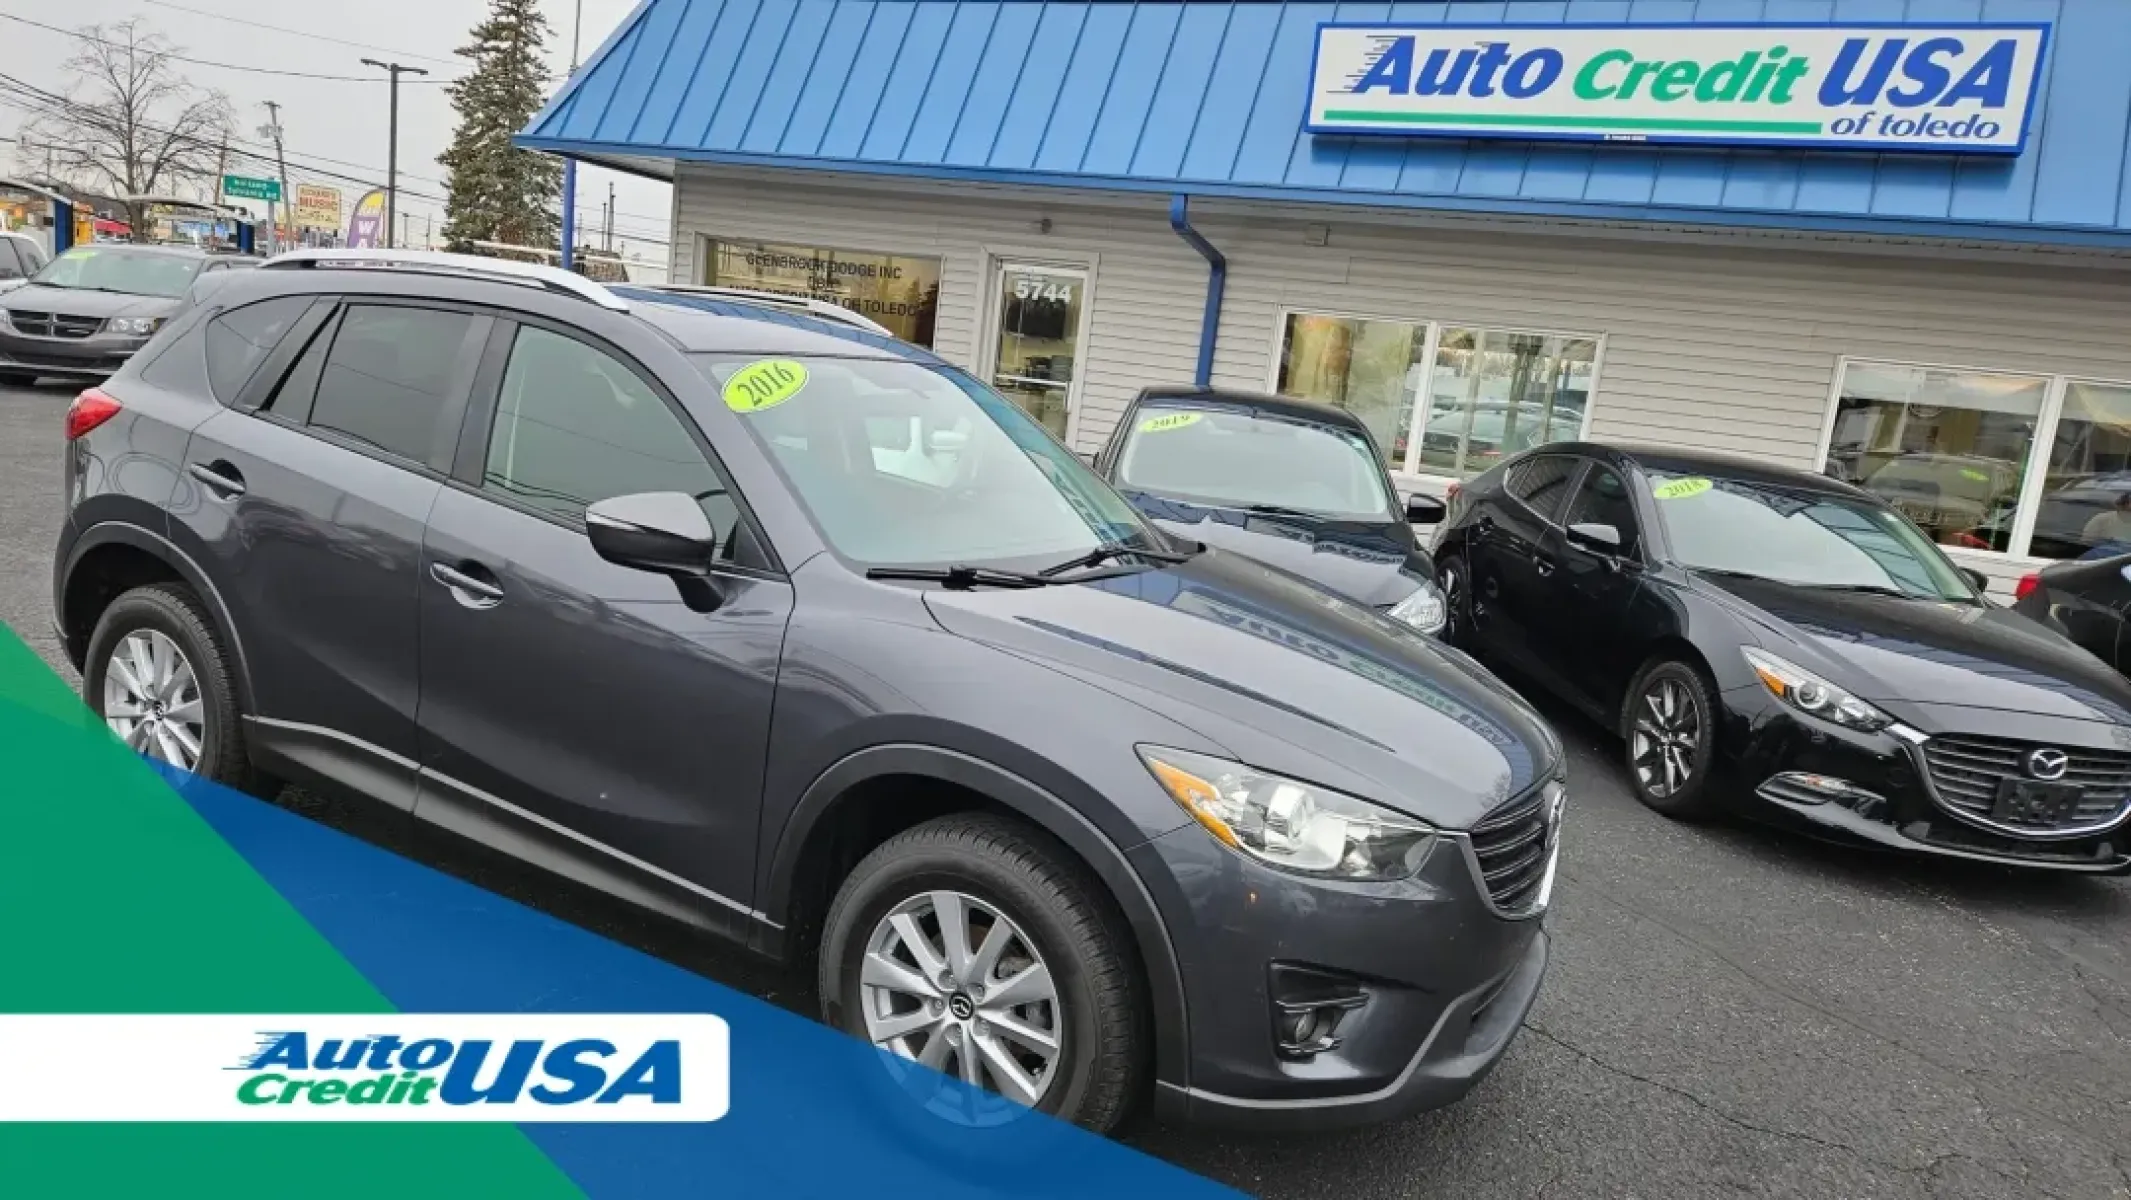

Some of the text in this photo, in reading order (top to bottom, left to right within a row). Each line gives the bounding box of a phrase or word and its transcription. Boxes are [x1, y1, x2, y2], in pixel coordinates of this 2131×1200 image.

[1346, 36, 2016, 107] Auto Credit USA
[1831, 112, 2000, 139] of toledo
[828, 260, 877, 277] DODGE
[879, 265, 903, 280] INC
[1015, 280, 1072, 304] 5744
[863, 299, 920, 316] TOLEDO
[738, 362, 795, 406] 2016
